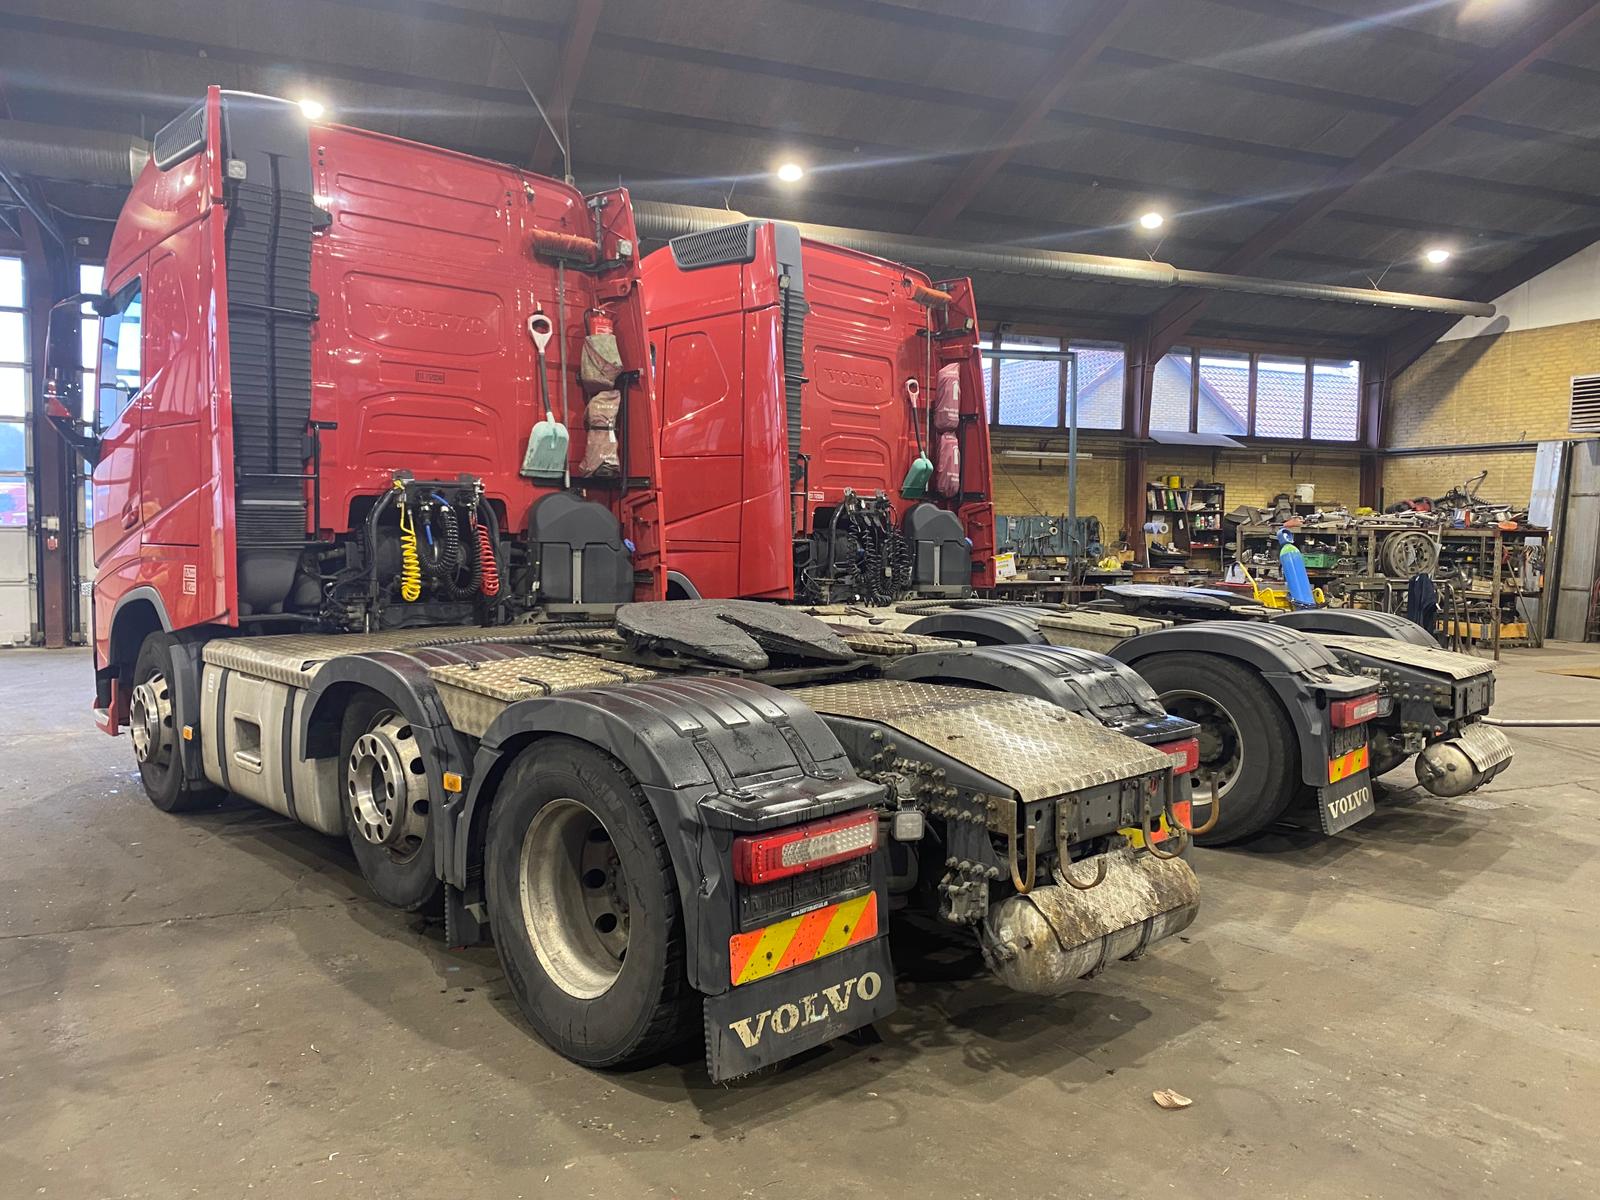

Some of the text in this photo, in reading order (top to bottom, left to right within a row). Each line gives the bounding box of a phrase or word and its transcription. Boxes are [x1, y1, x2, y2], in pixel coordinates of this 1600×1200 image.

[364, 302, 488, 335] VOLVO
[824, 367, 885, 390] VOLVO
[1328, 786, 1369, 819] VOLVO
[729, 972, 882, 1048] VOLVO
